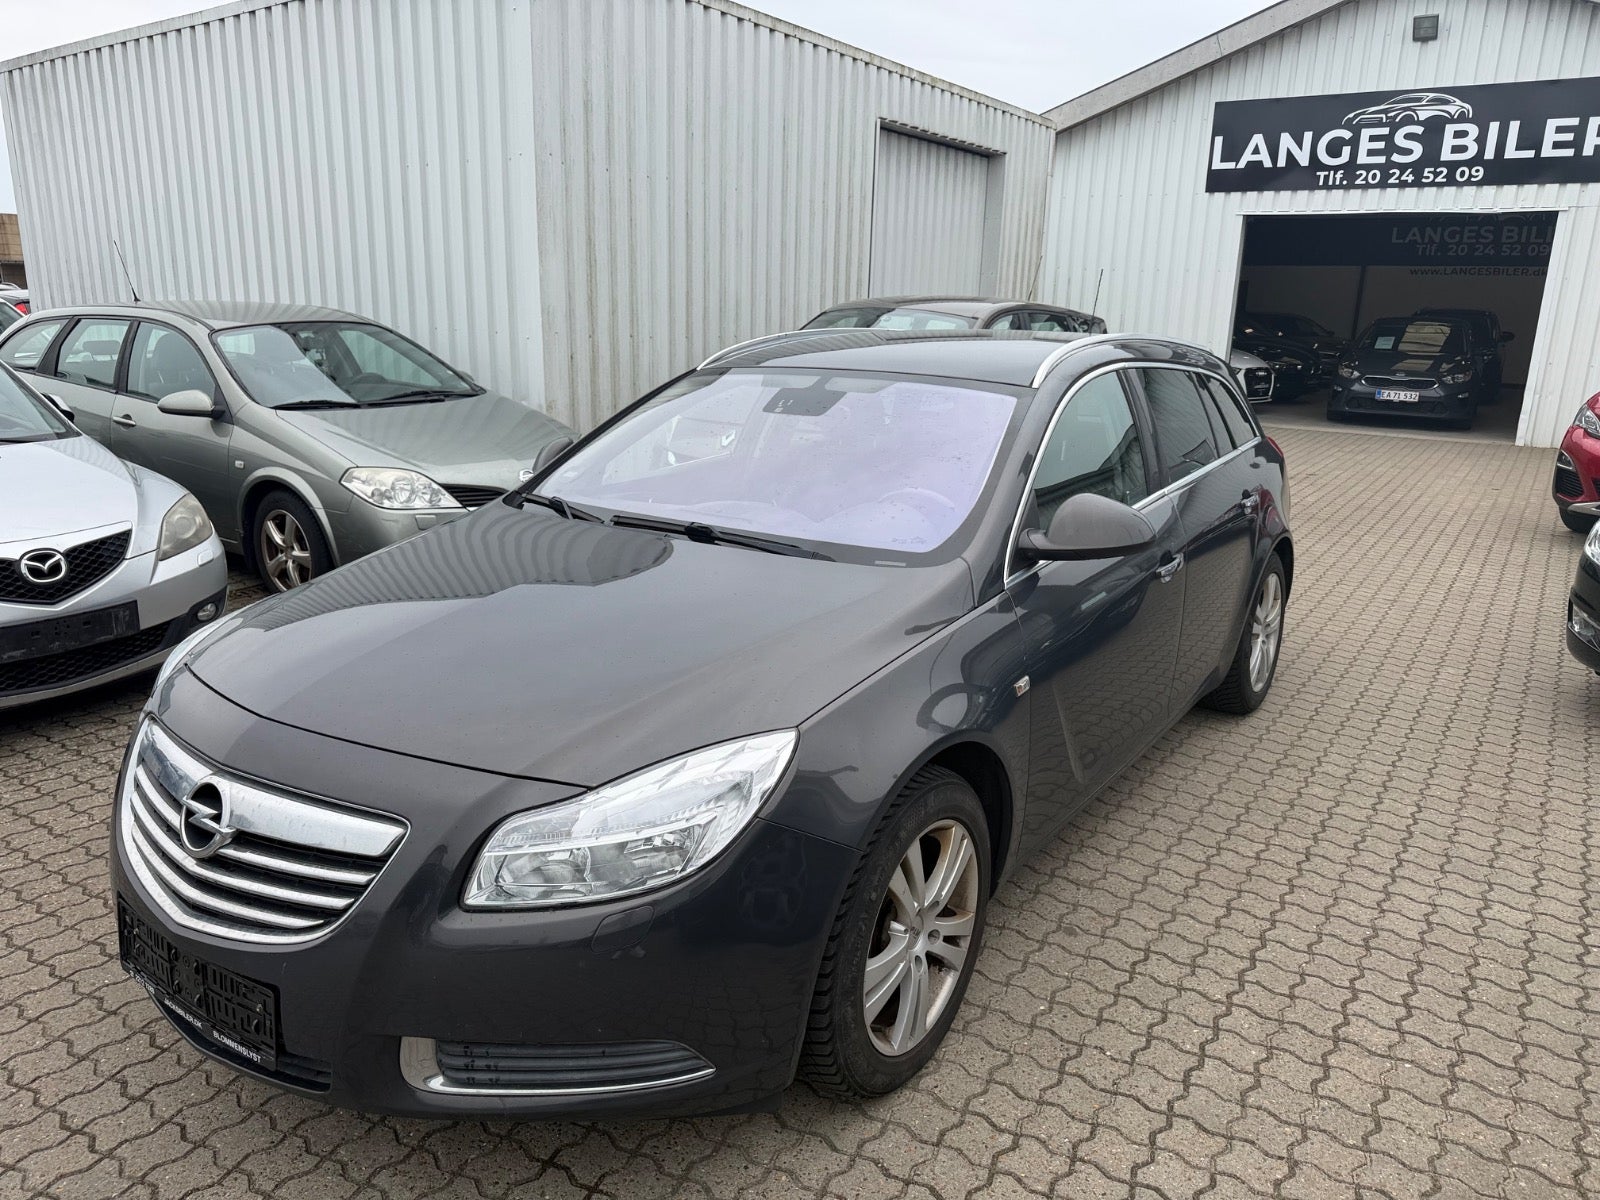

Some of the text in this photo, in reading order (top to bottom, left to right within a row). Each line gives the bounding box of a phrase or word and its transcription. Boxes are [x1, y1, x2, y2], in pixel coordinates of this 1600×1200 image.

[1211, 124, 1425, 170] LANGES
[1316, 166, 1484, 186] Tlf. 20 24 52 09
[1391, 225, 1494, 244] LANGES
[1416, 244, 1550, 256] Tlf. 20 24 52 09
[1381, 391, 1391, 399] EA
[1403, 392, 1418, 400] 532
